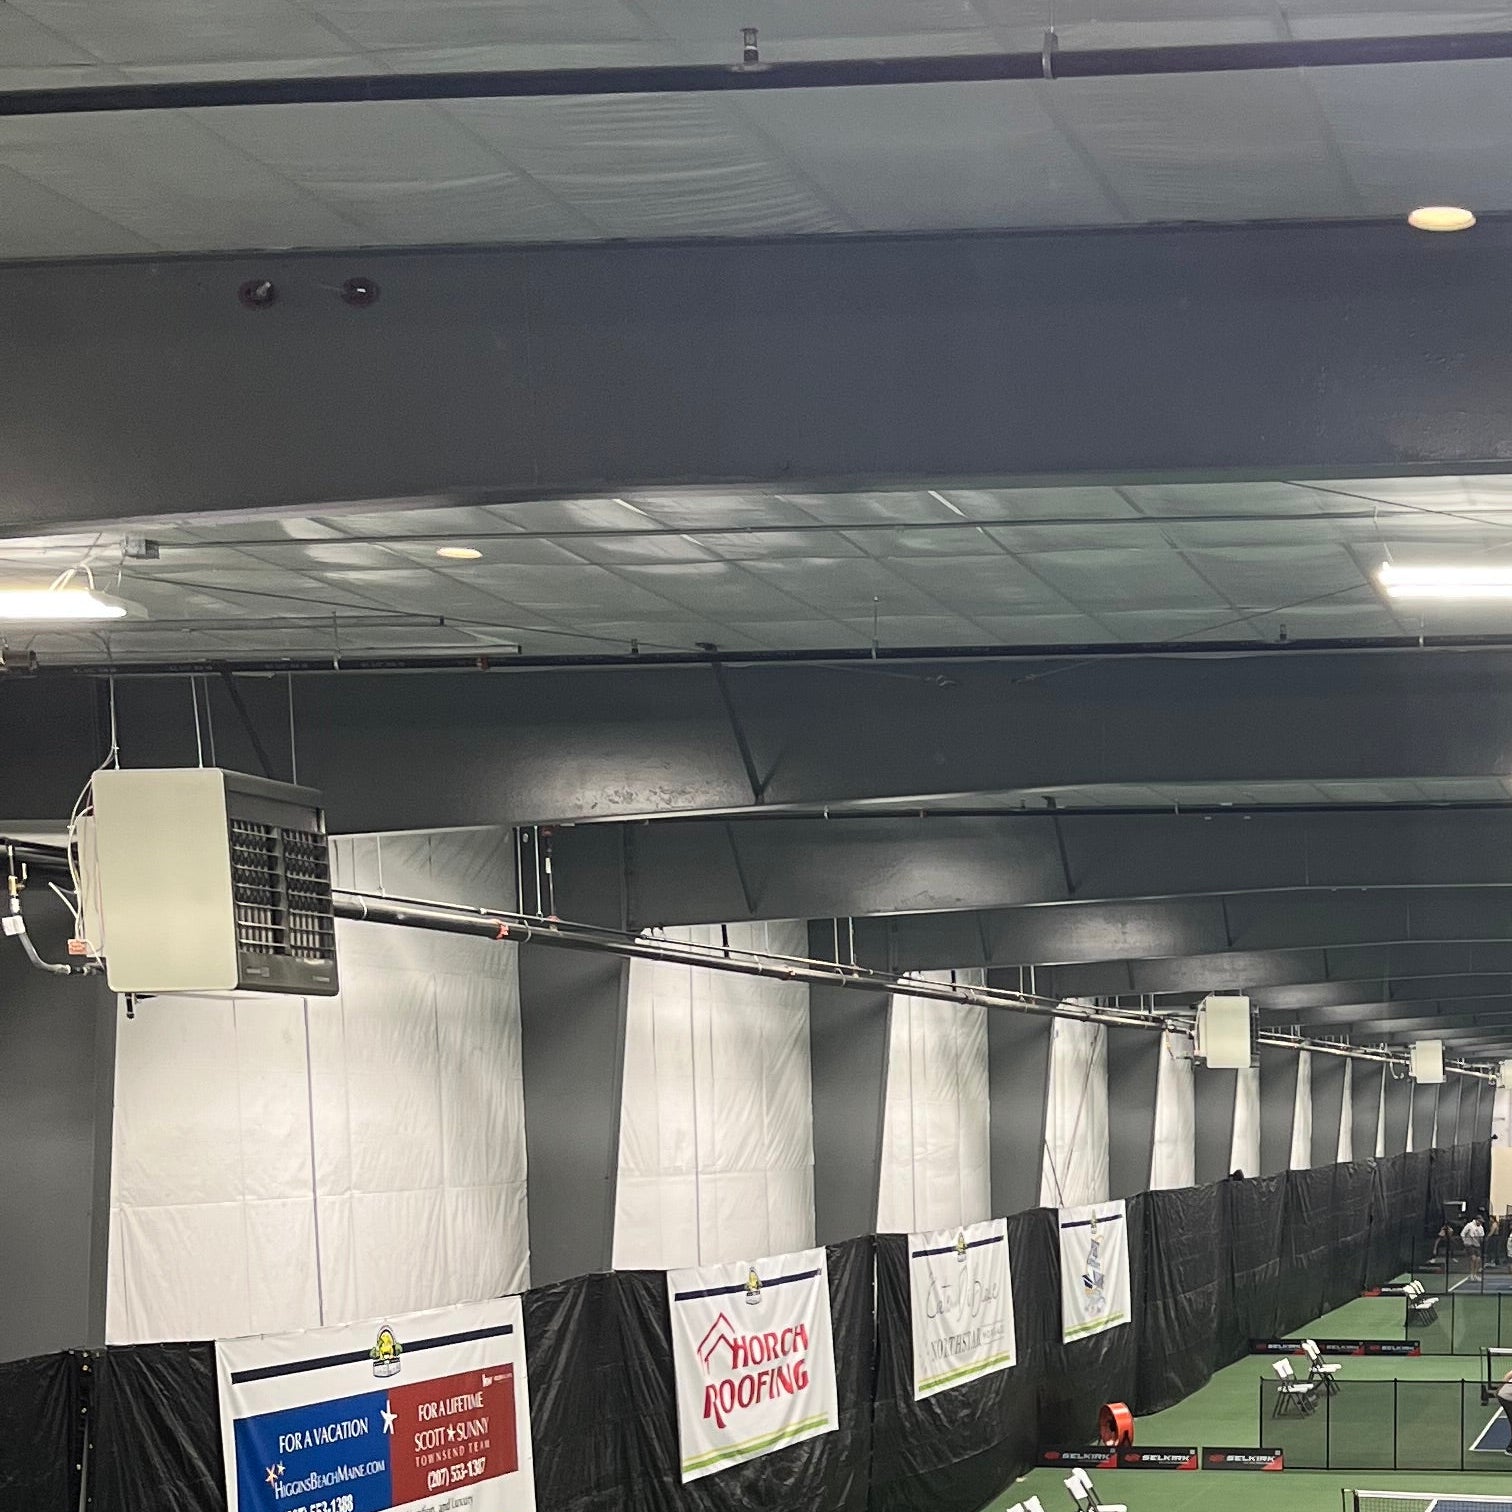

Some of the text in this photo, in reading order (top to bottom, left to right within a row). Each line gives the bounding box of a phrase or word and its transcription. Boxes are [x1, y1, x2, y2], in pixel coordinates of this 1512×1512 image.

[732, 1324, 809, 1370] HORCH
[418, 1391, 484, 1421] FOR A LIFETIME
[703, 1359, 809, 1429] ROOFING
[279, 1417, 369, 1453] FOR A VACATION
[414, 1416, 489, 1452] SCOTT SUNNY
[415, 1439, 491, 1468] TOWNSEND TEAM
[427, 1467, 450, 1492] (207)
[438, 1501, 450, 1512] and
